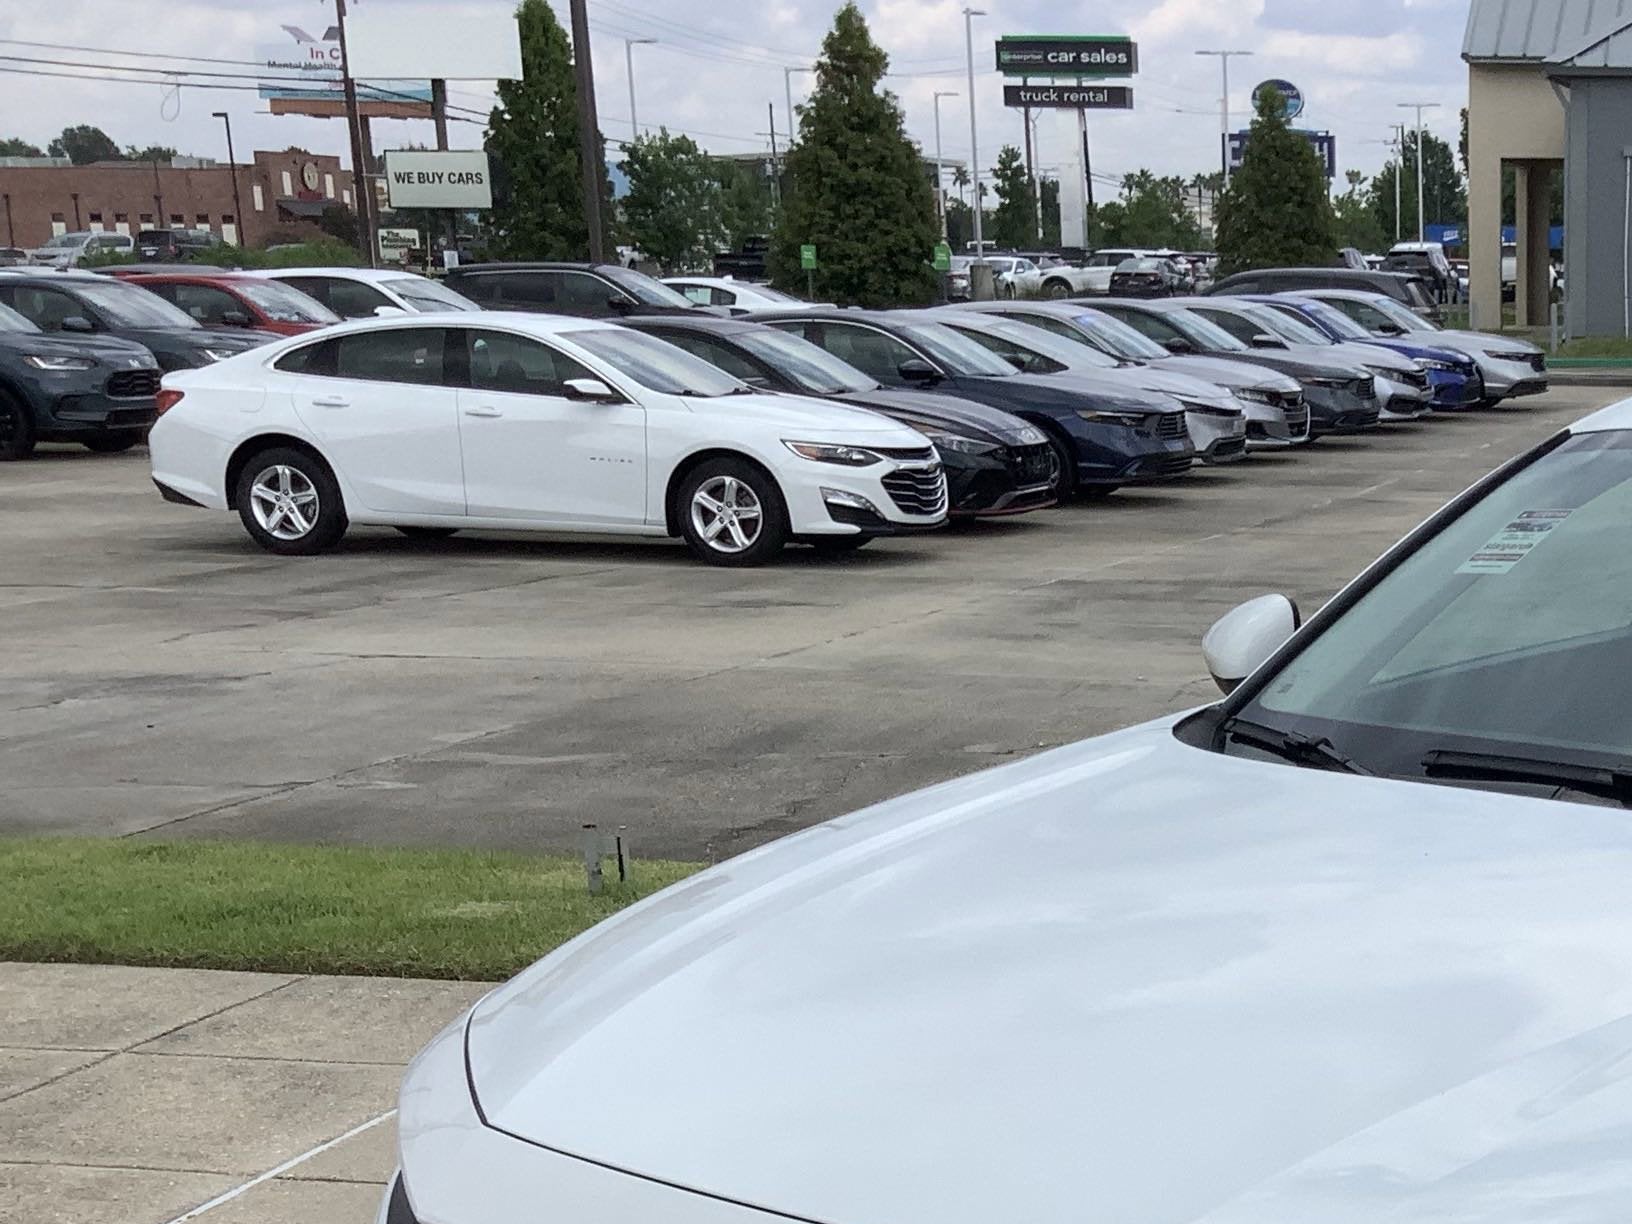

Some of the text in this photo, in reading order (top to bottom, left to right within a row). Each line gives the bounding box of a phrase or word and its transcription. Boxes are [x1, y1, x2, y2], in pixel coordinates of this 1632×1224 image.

[310, 47, 324, 59] In
[1047, 51, 1077, 63] car
[1080, 48, 1128, 64] sales
[1019, 89, 1108, 103] truck rental
[394, 172, 484, 185] WE BUY CARS
